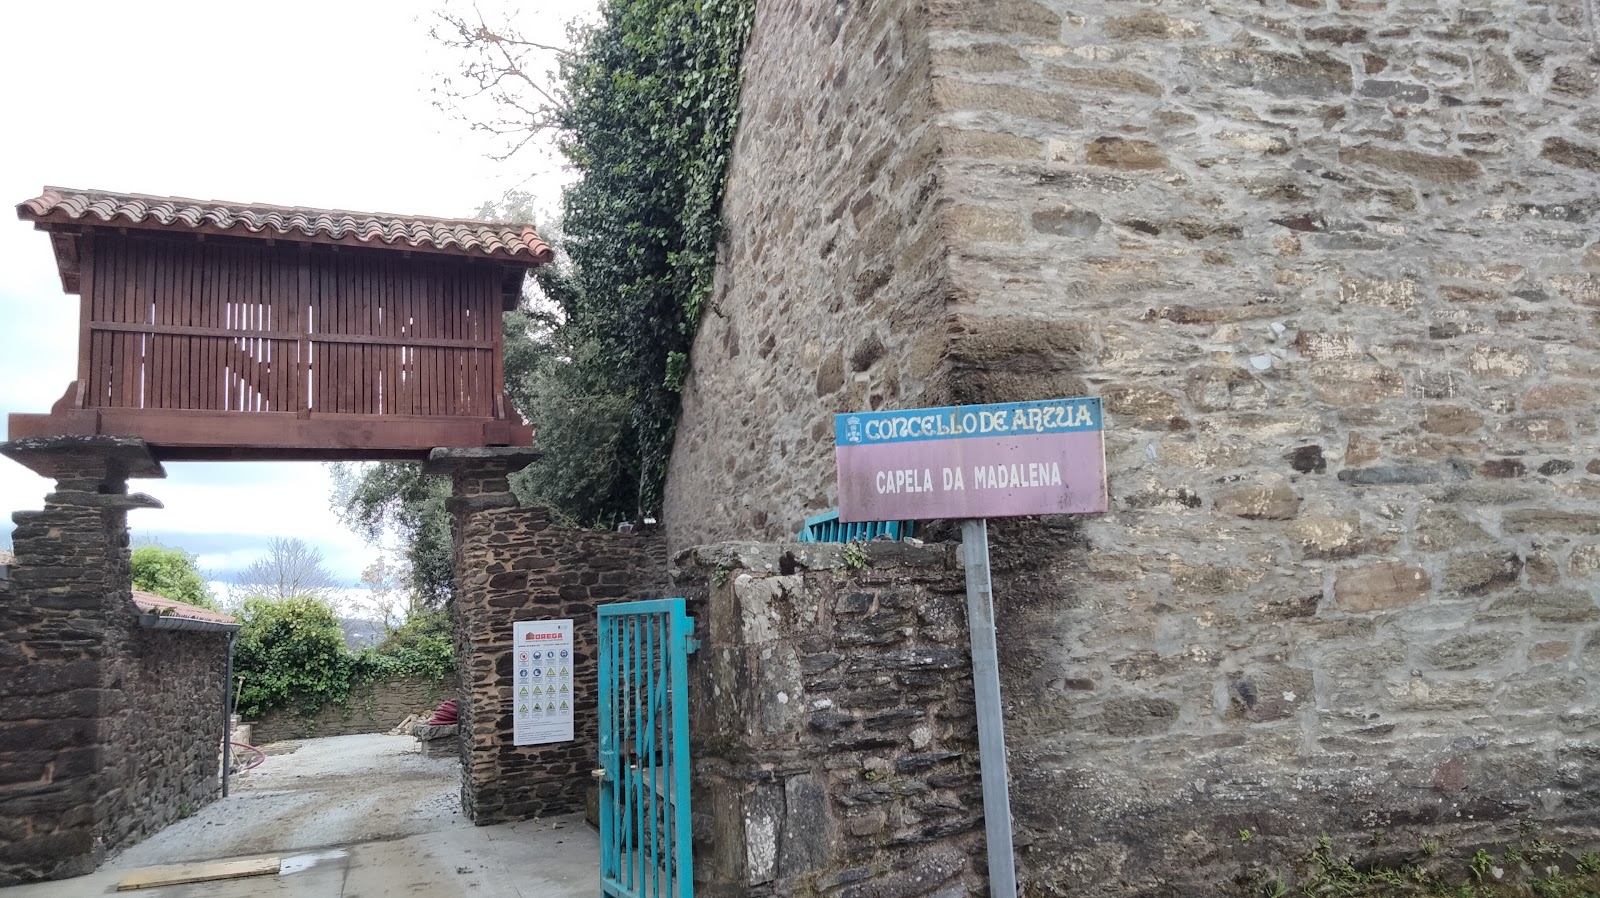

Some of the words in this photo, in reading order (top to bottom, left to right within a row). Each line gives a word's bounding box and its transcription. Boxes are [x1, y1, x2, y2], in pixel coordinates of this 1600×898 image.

[866, 412, 977, 440] CONCELLO
[980, 410, 1008, 433] DE
[876, 468, 933, 495] CAPELA
[943, 466, 964, 491] DA
[974, 462, 1062, 489] MADALENA
